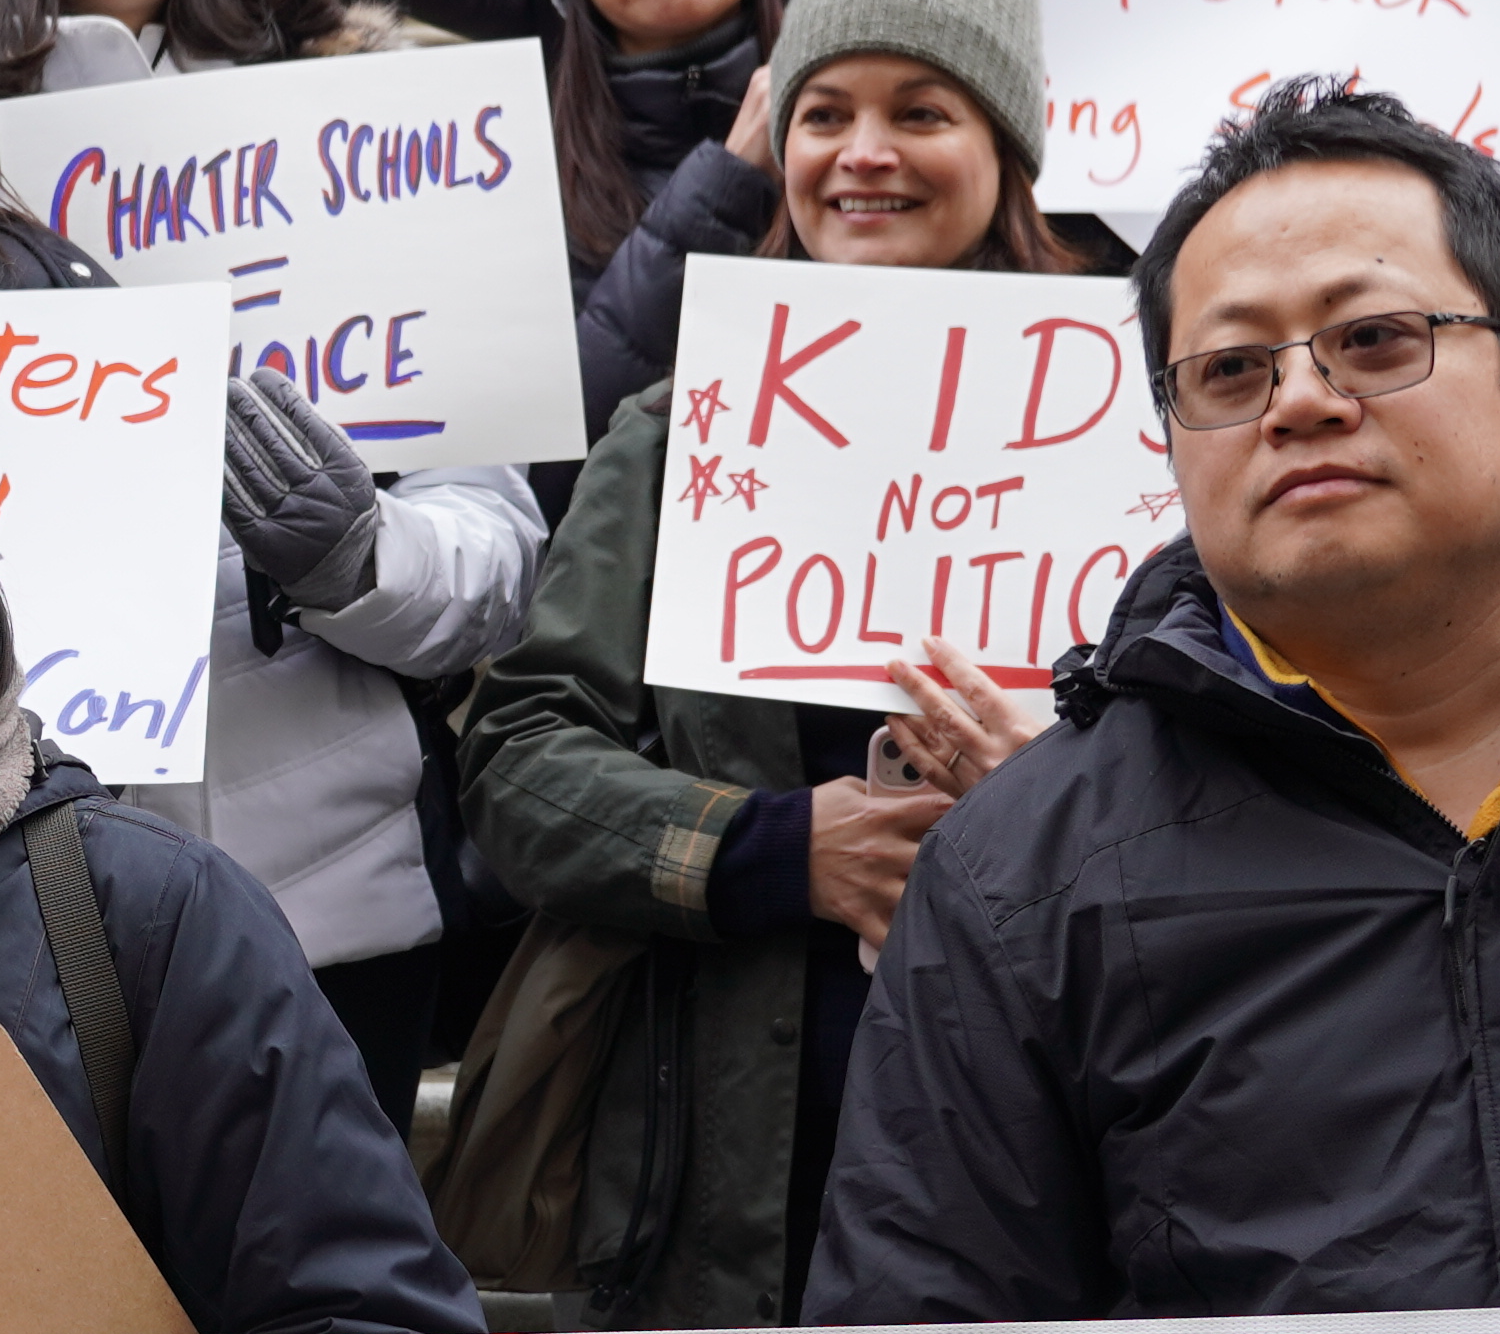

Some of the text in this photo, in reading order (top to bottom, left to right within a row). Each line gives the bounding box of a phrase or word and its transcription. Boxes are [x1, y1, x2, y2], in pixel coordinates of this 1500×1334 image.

[48, 104, 513, 261] CHARTER SCHOOLS
[875, 473, 1025, 542] NOT
[720, 536, 1150, 665] POLITIC
